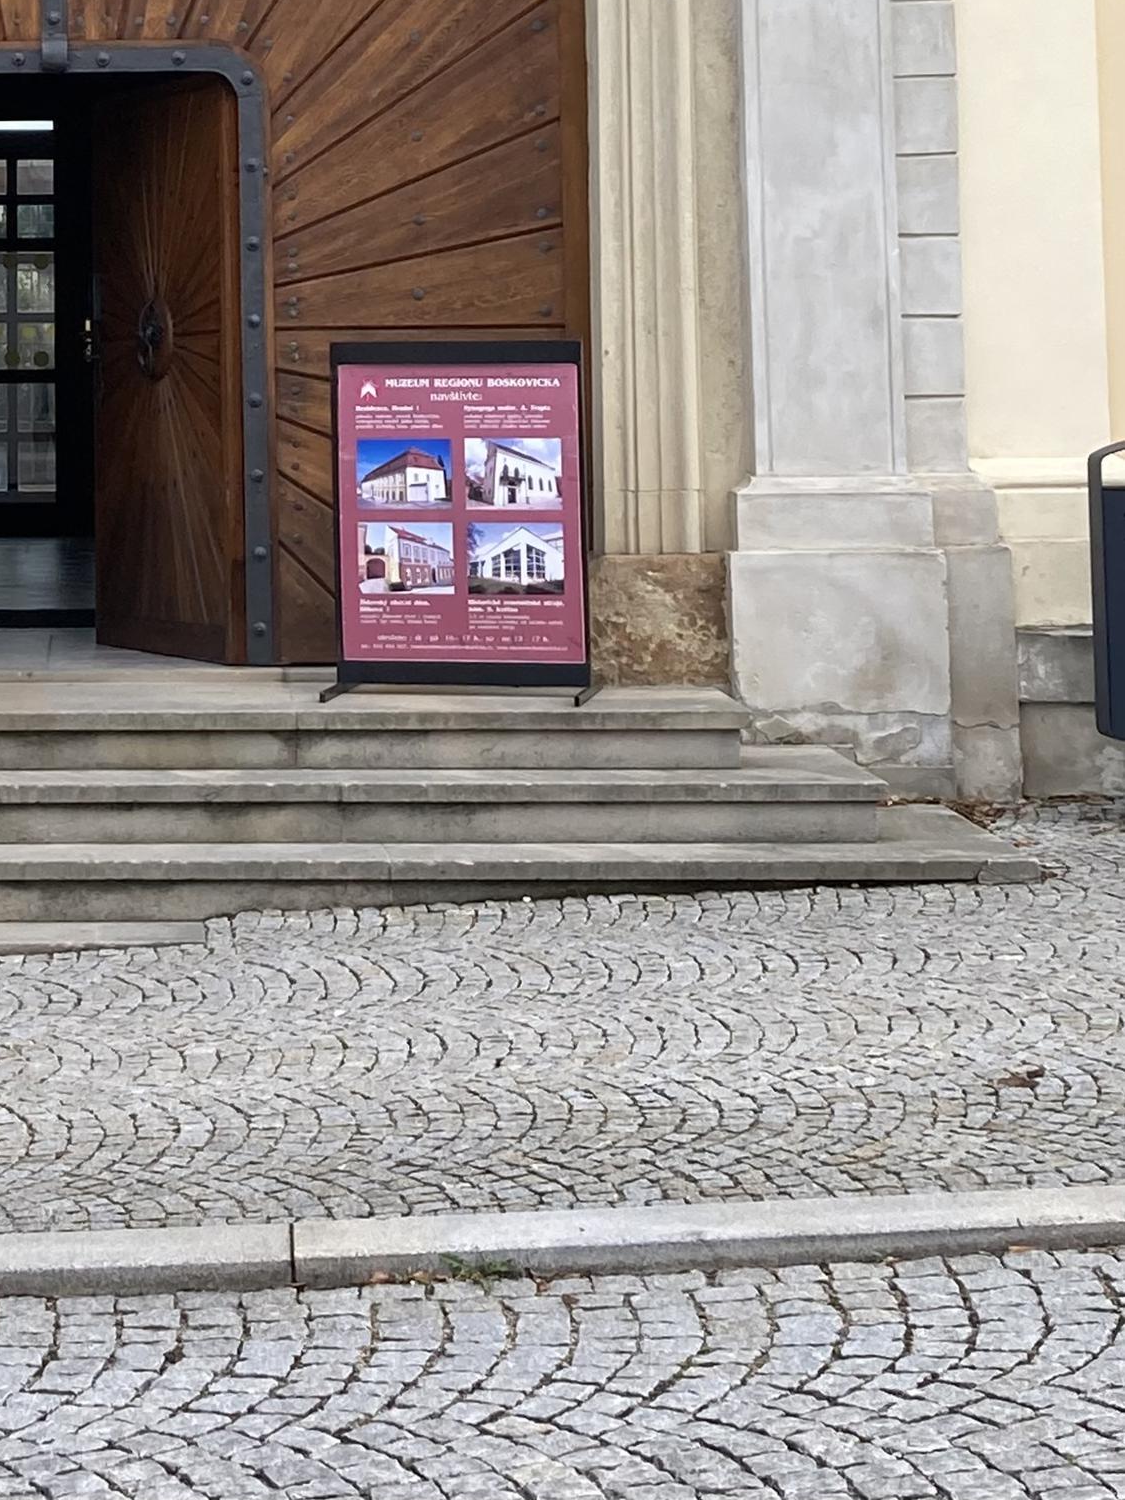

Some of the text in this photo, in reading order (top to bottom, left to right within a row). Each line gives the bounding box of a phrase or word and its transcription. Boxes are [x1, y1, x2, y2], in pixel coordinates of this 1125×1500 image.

[385, 378, 560, 388] MUZEUM REGIONU BOSKOVICKA
